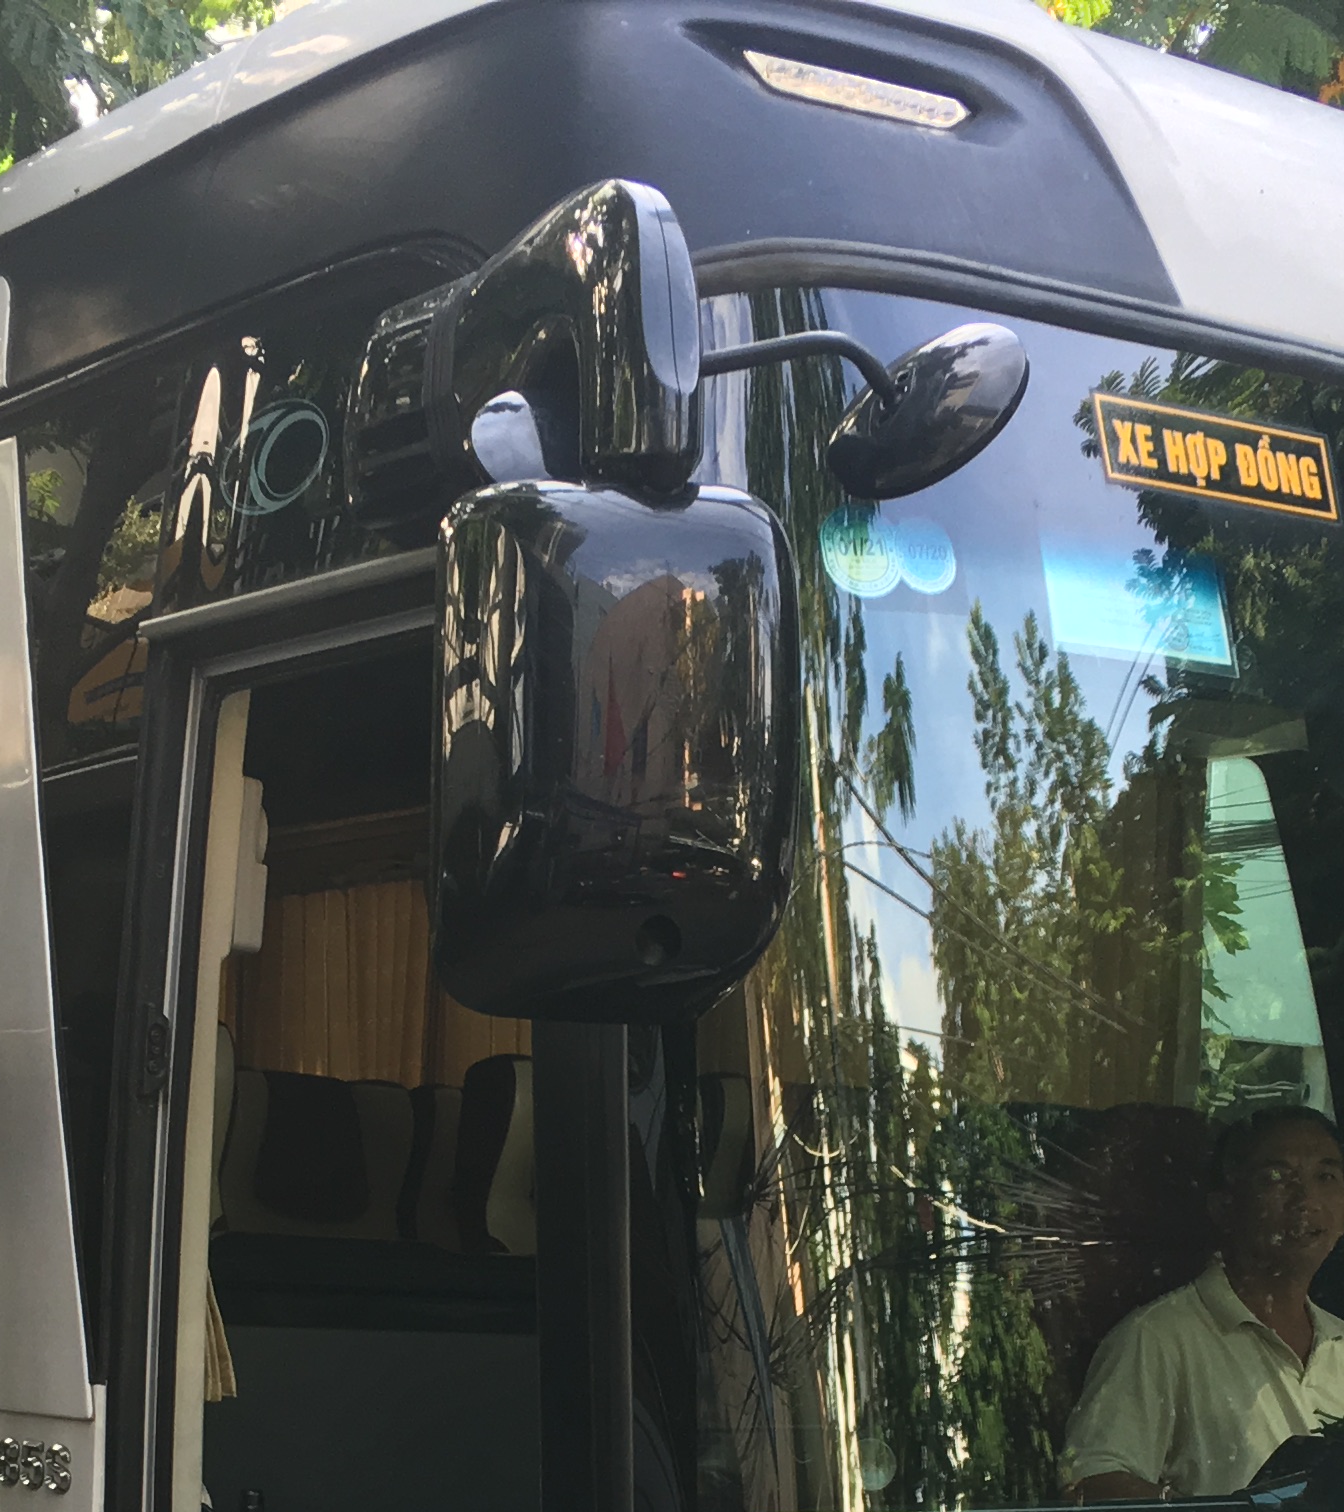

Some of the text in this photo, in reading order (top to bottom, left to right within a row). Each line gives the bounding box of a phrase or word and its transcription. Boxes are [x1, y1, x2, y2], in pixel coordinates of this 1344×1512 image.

[1112, 419, 1322, 500] XE HỢP ĐỒNG
